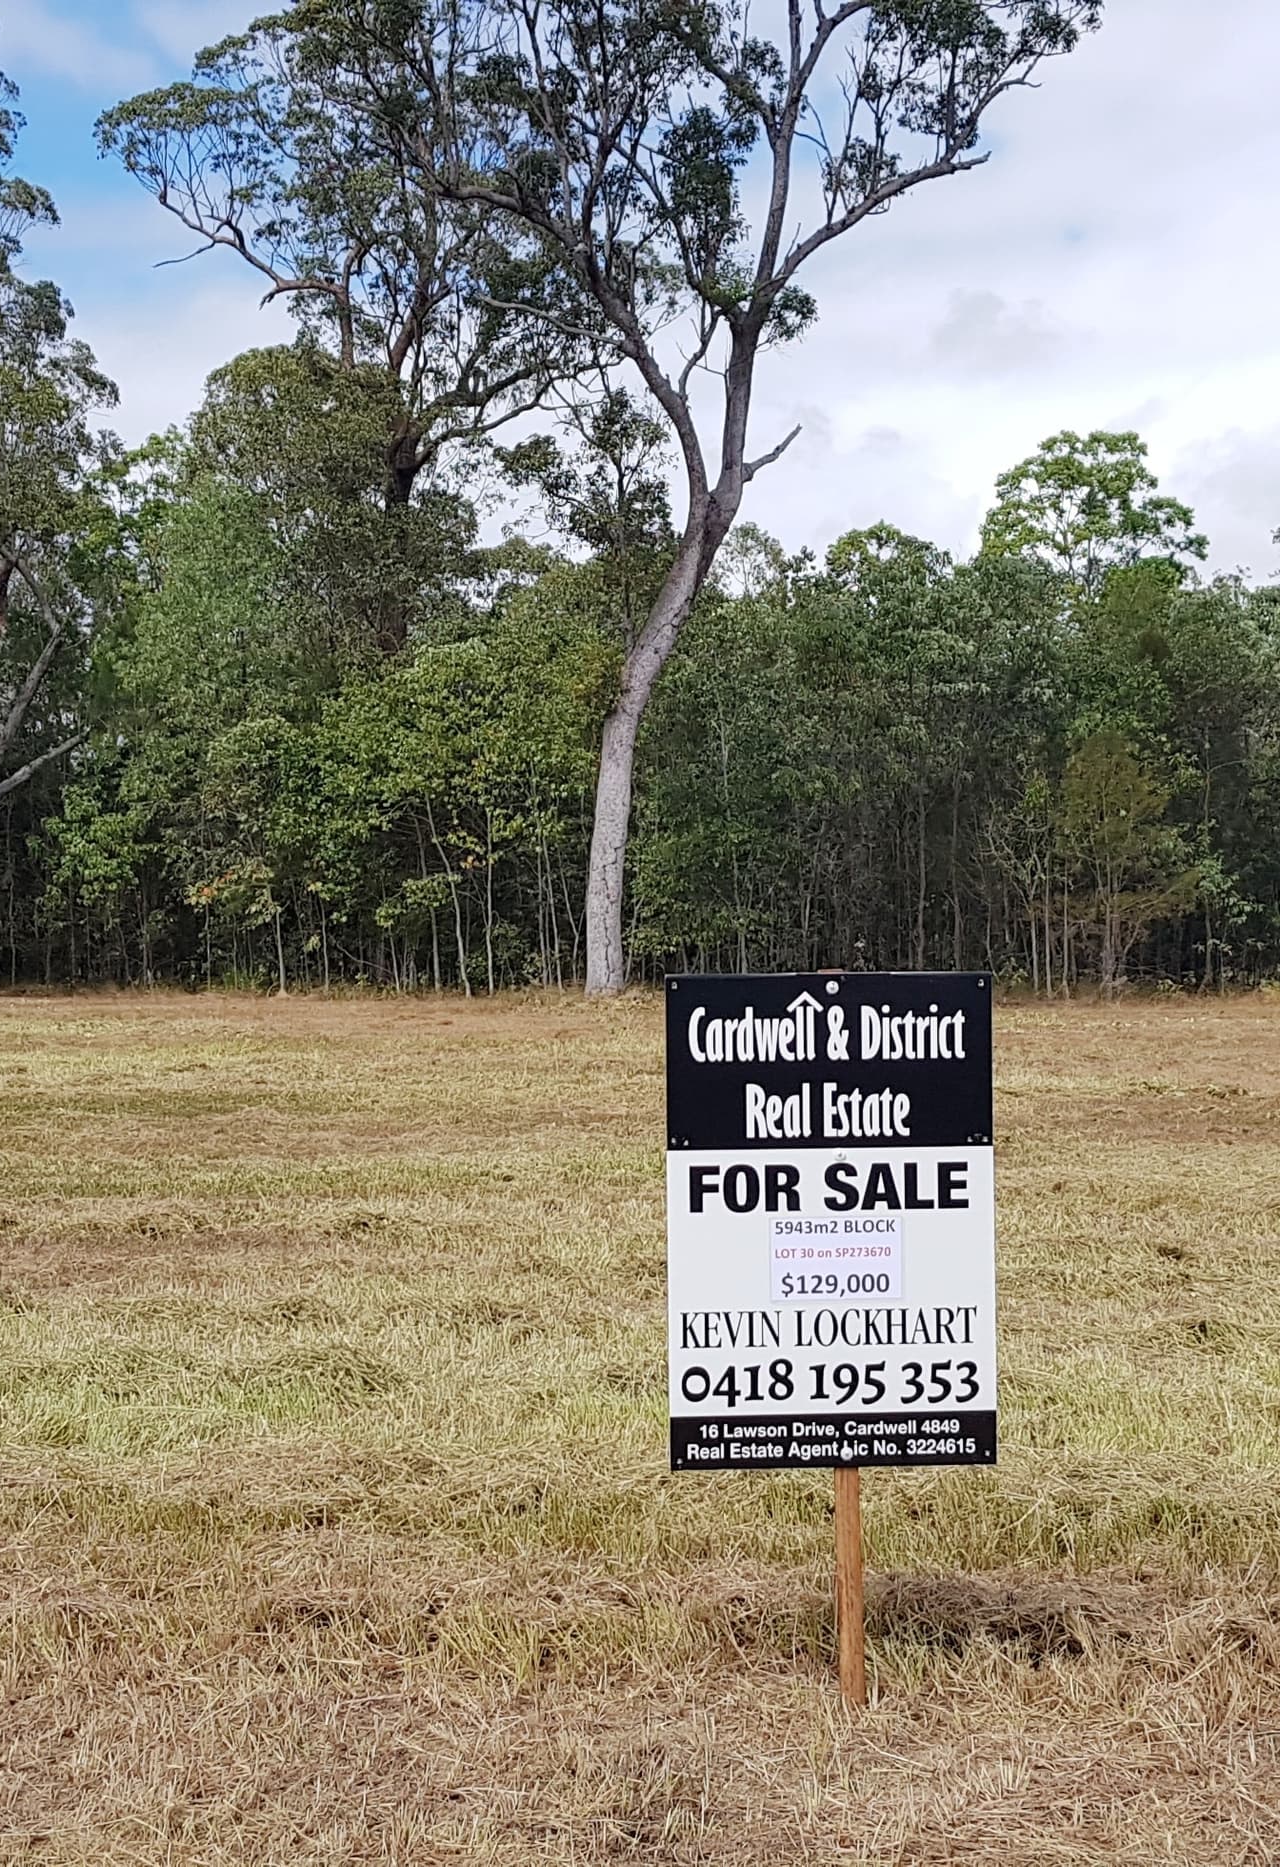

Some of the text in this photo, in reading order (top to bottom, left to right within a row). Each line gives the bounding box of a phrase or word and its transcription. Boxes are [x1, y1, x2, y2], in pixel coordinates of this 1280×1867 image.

[688, 1000, 965, 1062] Cardwell & District
[745, 1082, 911, 1138] Real Estate
[688, 1161, 969, 1213] FOR SALE
[774, 1219, 896, 1234] 5943m2 BLOCK
[774, 1246, 891, 1259] LOT 30 on SP273670
[781, 1272, 890, 1297] $129,000
[680, 1306, 977, 1349] KEVIN LOCKHART
[681, 1358, 980, 1407] 0418 195 353
[699, 1419, 960, 1439] 16 Lawson Drive, Cardwell 4849
[687, 1443, 725, 1460] Real
[729, 1442, 783, 1458] Estate
[789, 1442, 839, 1459] Agent
[873, 1439, 902, 1456] No.
[906, 1438, 976, 1455] 3224615
